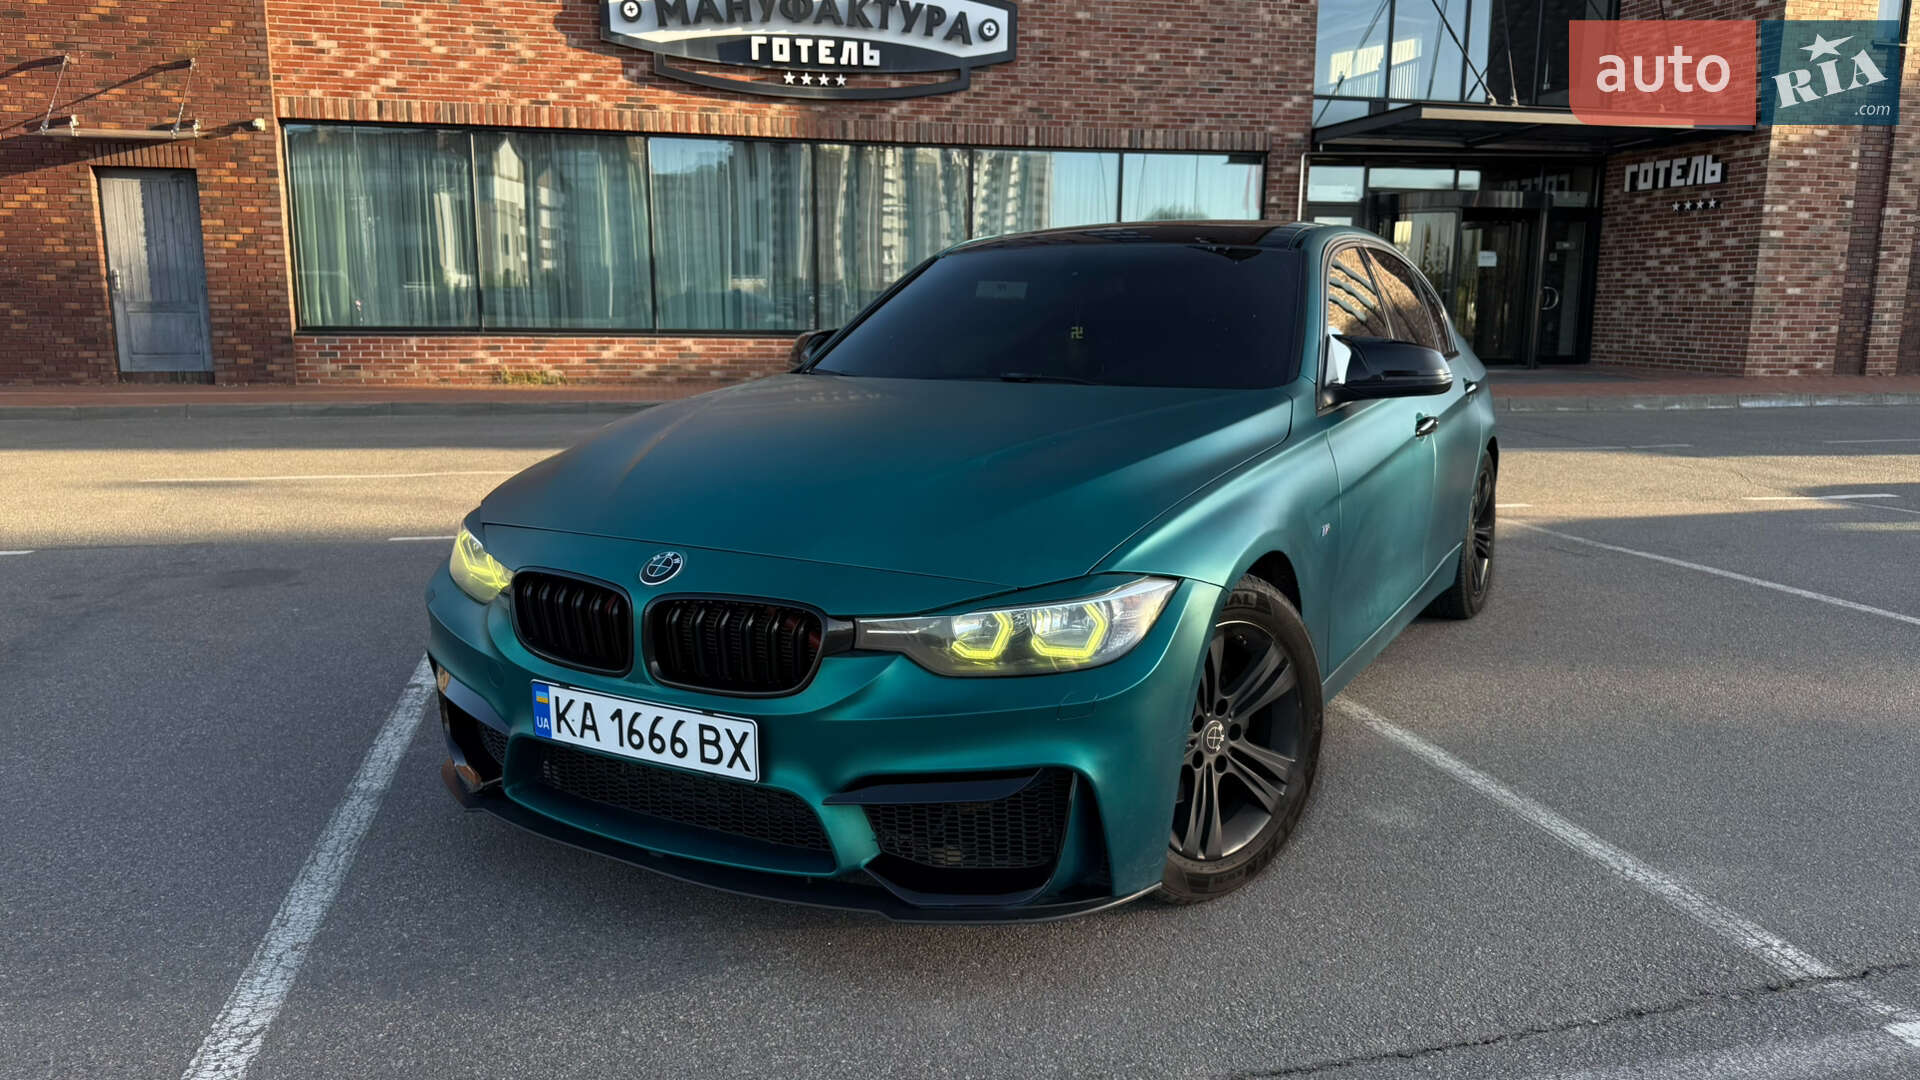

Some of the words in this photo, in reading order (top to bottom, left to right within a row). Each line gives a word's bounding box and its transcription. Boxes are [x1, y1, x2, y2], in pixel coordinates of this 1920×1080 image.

[655, 0, 973, 46] МАНУФАКТУРА
[751, 36, 881, 67] ГОТЕЛЬ
[1624, 154, 1723, 193] ГОТЕЛЬ
[536, 716, 550, 729] UA
[554, 696, 600, 742] KA
[610, 708, 688, 759] 1666
[699, 723, 751, 772] BX
